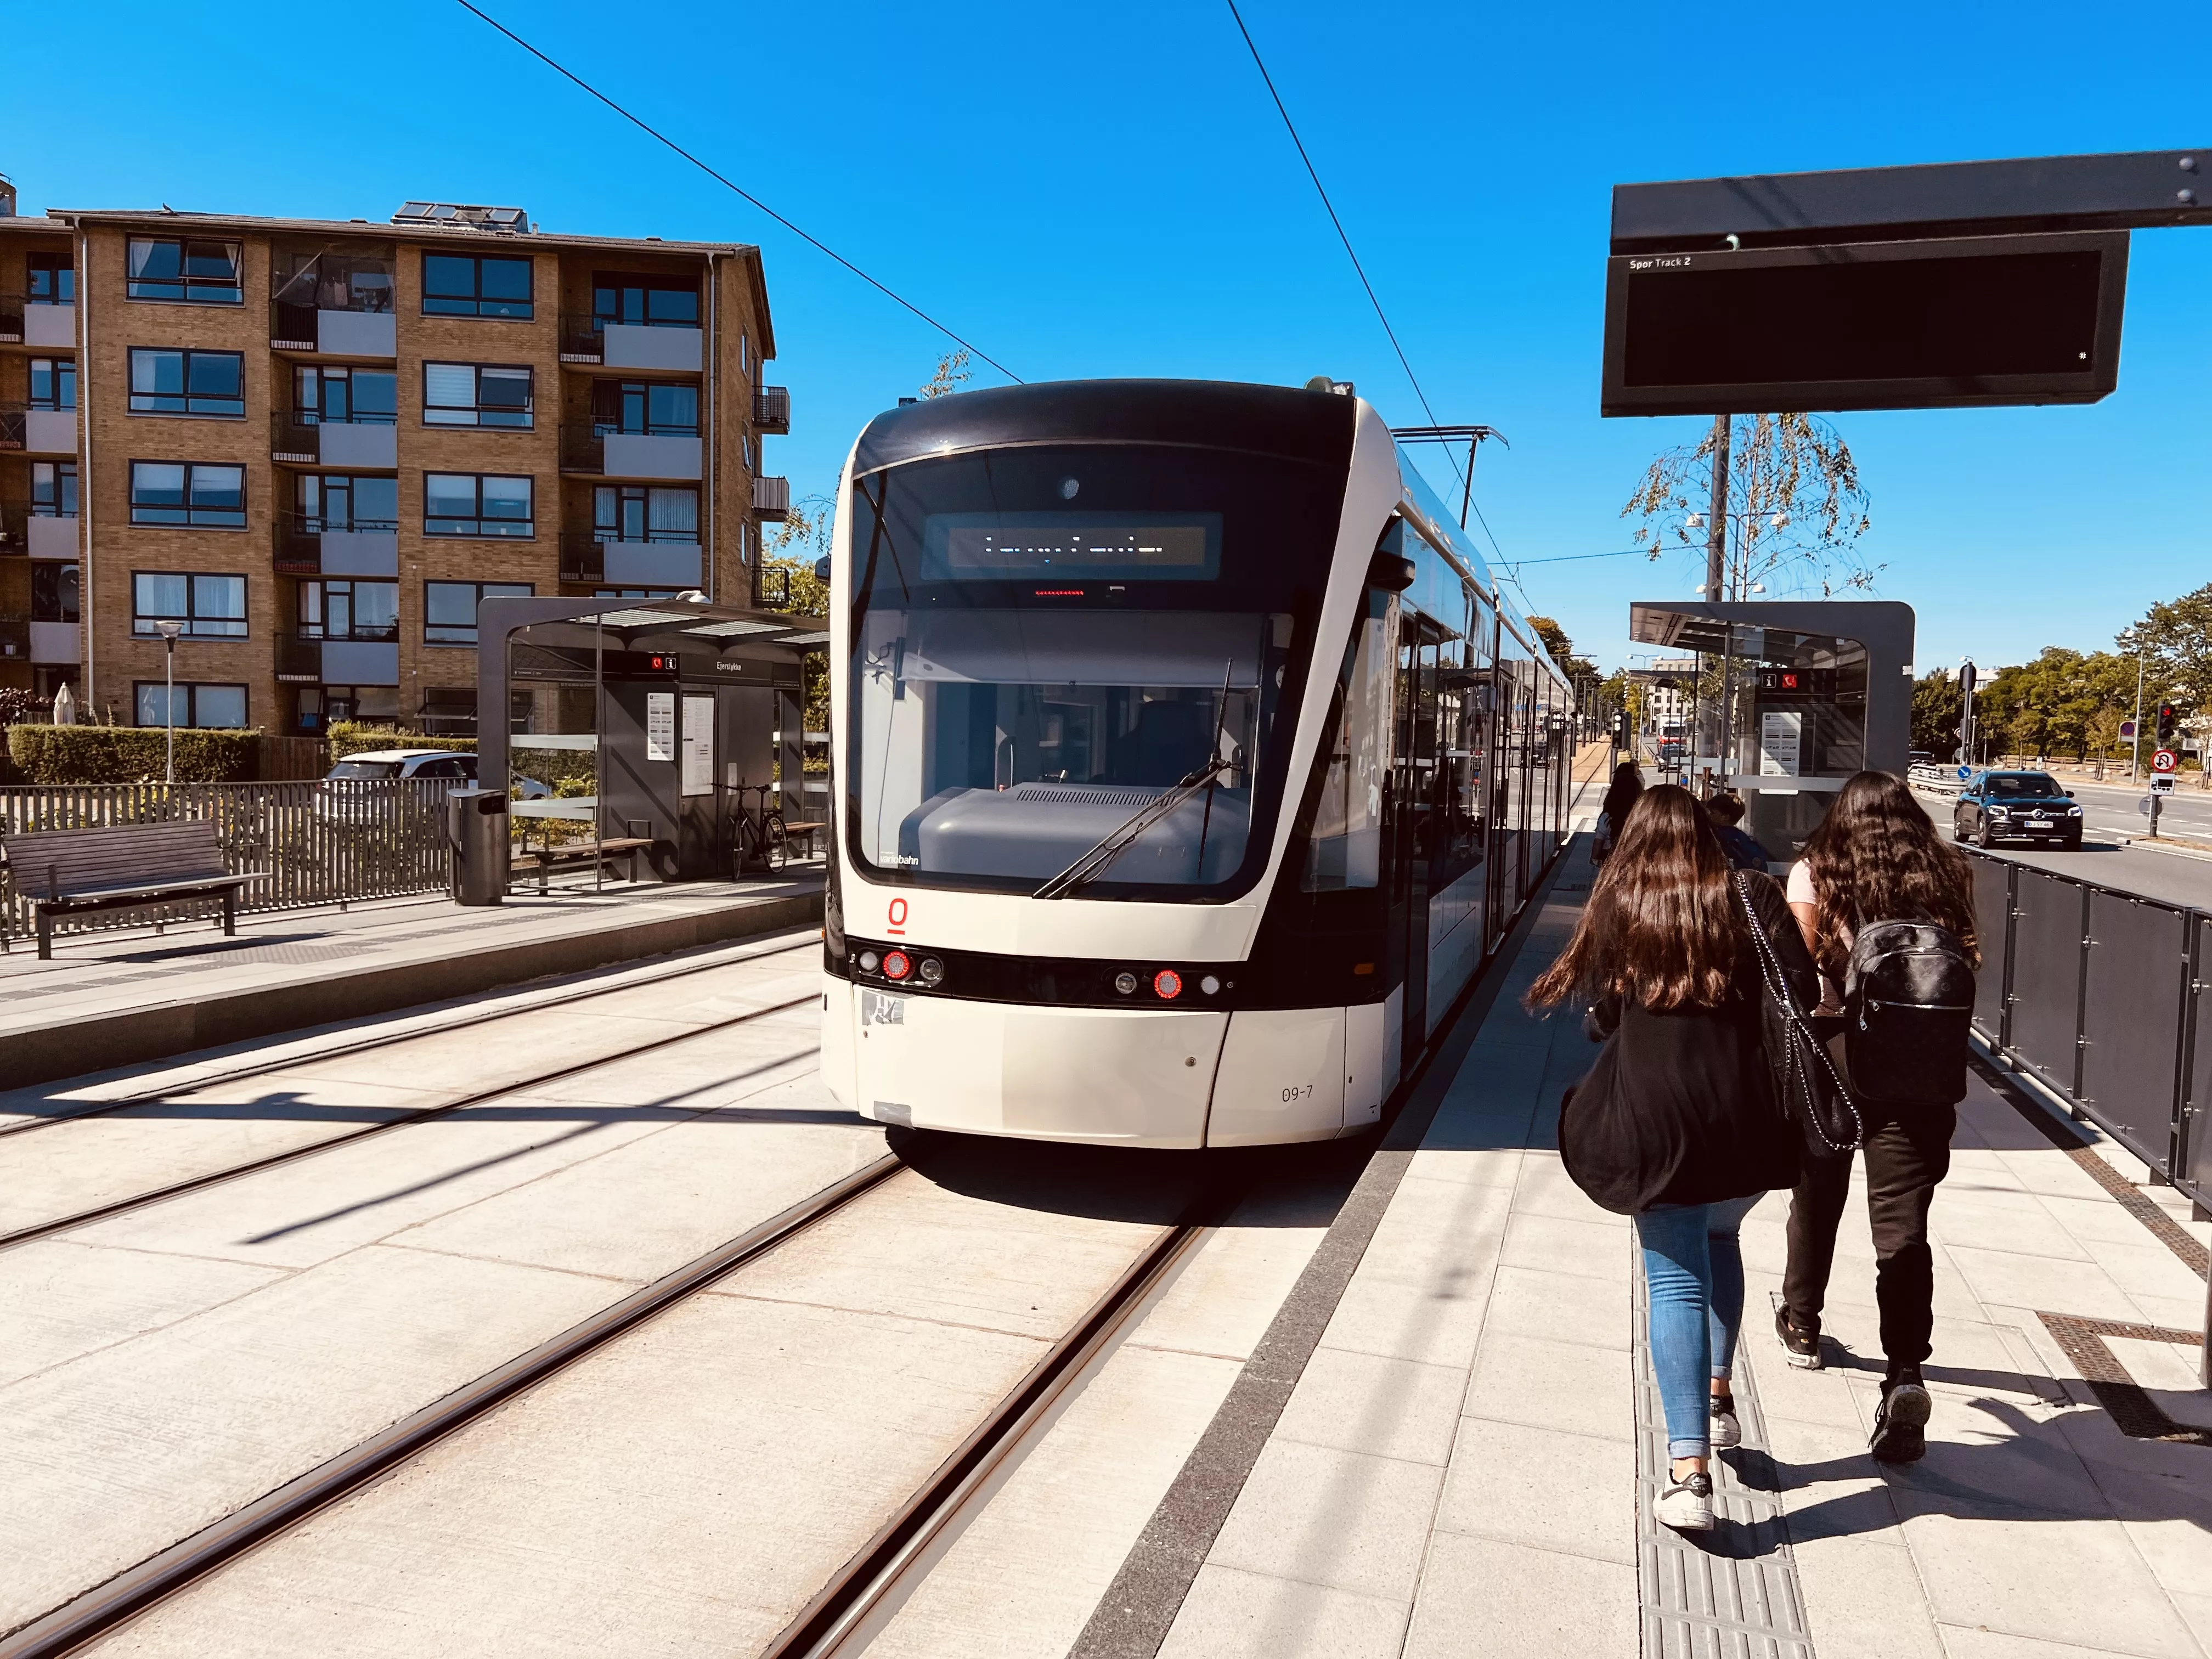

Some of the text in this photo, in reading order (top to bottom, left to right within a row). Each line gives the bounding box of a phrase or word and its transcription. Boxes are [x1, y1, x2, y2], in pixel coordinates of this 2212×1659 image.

[1630, 257, 1691, 270] Spor Track 2
[716, 661, 742, 672] Ejerslykke
[880, 854, 919, 865] variobahn
[1282, 1085, 1313, 1102] 09-7
